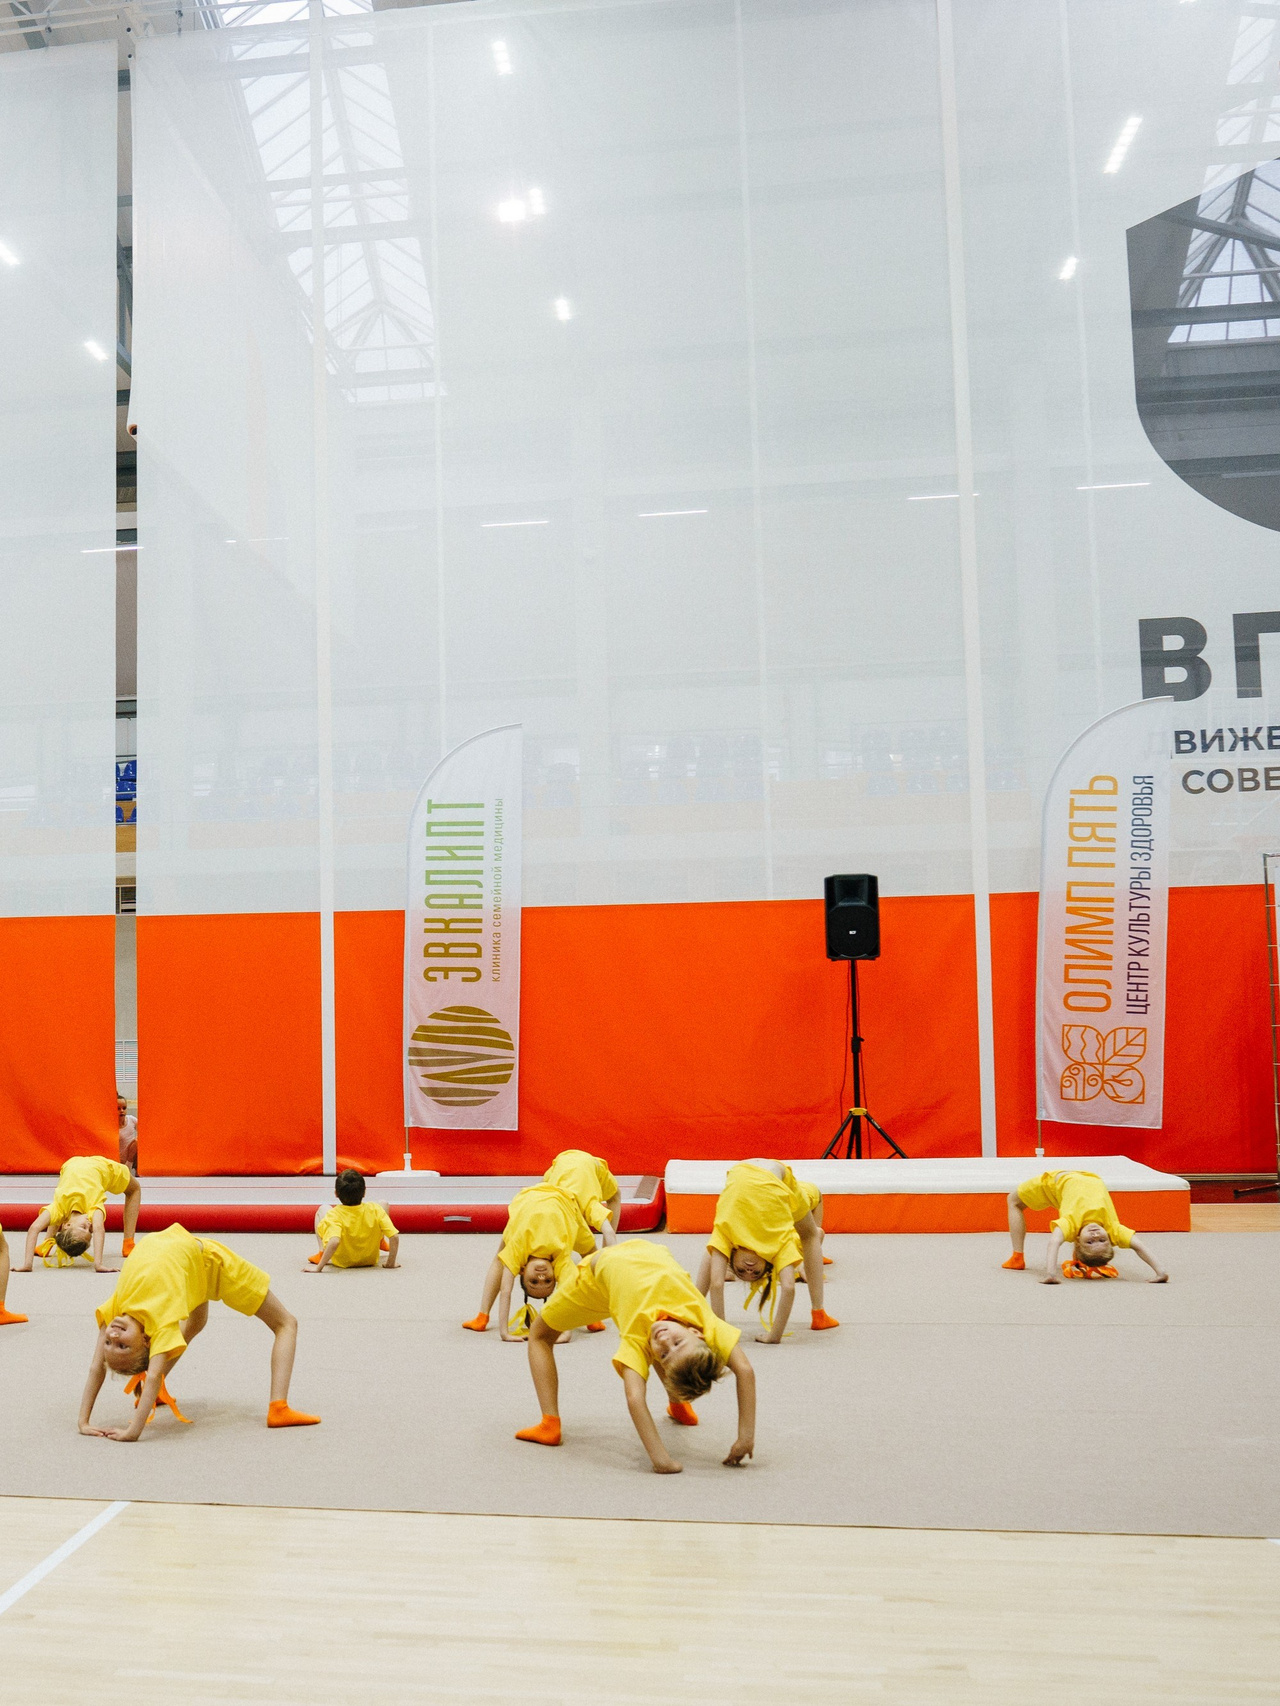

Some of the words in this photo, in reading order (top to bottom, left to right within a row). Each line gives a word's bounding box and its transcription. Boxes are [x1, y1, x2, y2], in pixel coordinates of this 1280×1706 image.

[1171, 725, 1280, 759] ВИЖЕ
[494, 798, 505, 862] медицины
[1067, 774, 1119, 868] ПЯТЬ
[1130, 775, 1155, 862] ЗДОРОВЬЯ
[423, 799, 485, 983] ЭВКАЛИПТ
[491, 866, 503, 928] семейной
[1128, 866, 1152, 957] КУЛЬТУРЫ
[492, 931, 501, 983] клиника
[1063, 881, 1115, 1013] ОЛИМП
[1126, 961, 1150, 1015] ЦЕНТР
